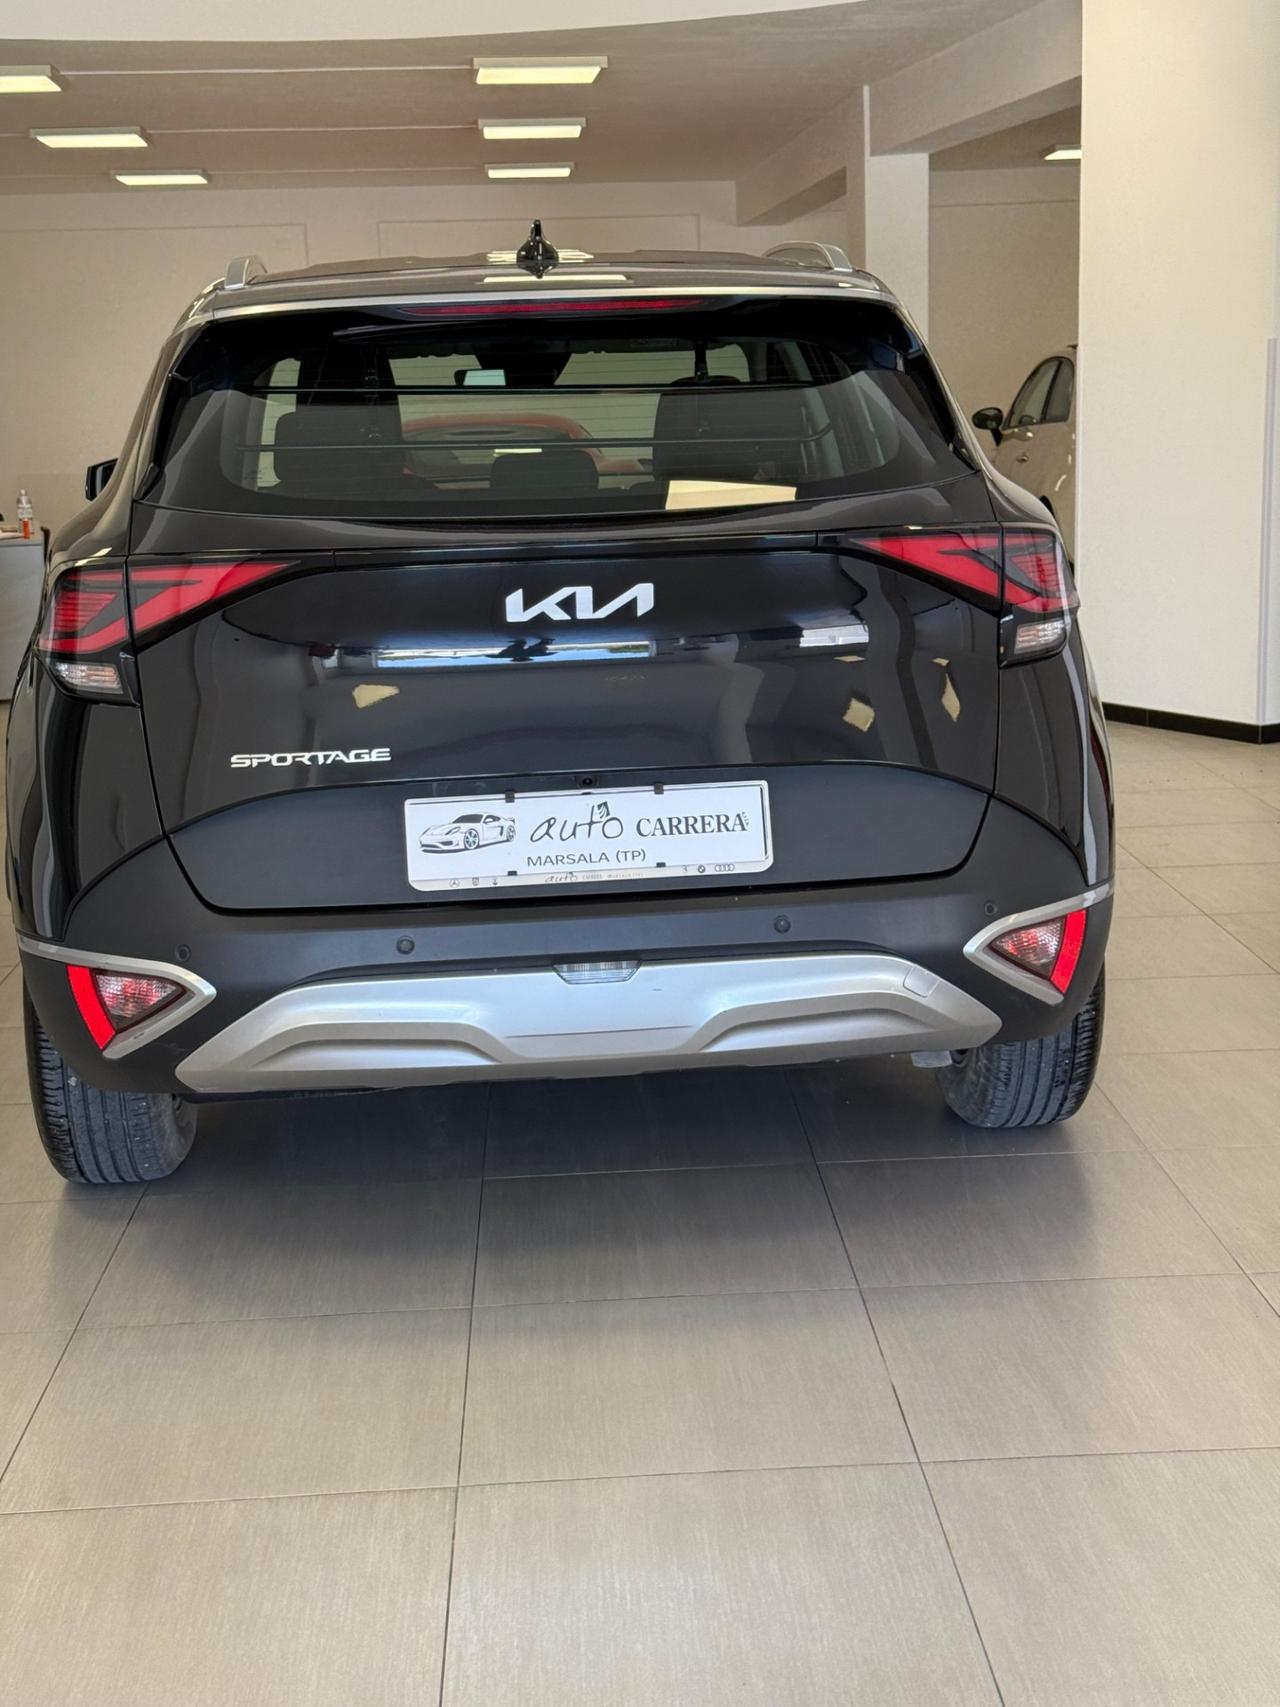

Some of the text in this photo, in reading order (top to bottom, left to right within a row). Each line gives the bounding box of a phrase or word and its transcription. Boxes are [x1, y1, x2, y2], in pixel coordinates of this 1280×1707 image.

[230, 747, 392, 768] SPORTAGE
[636, 812, 748, 838] CARRERA
[526, 848, 647, 867] MARSALA (TP)
